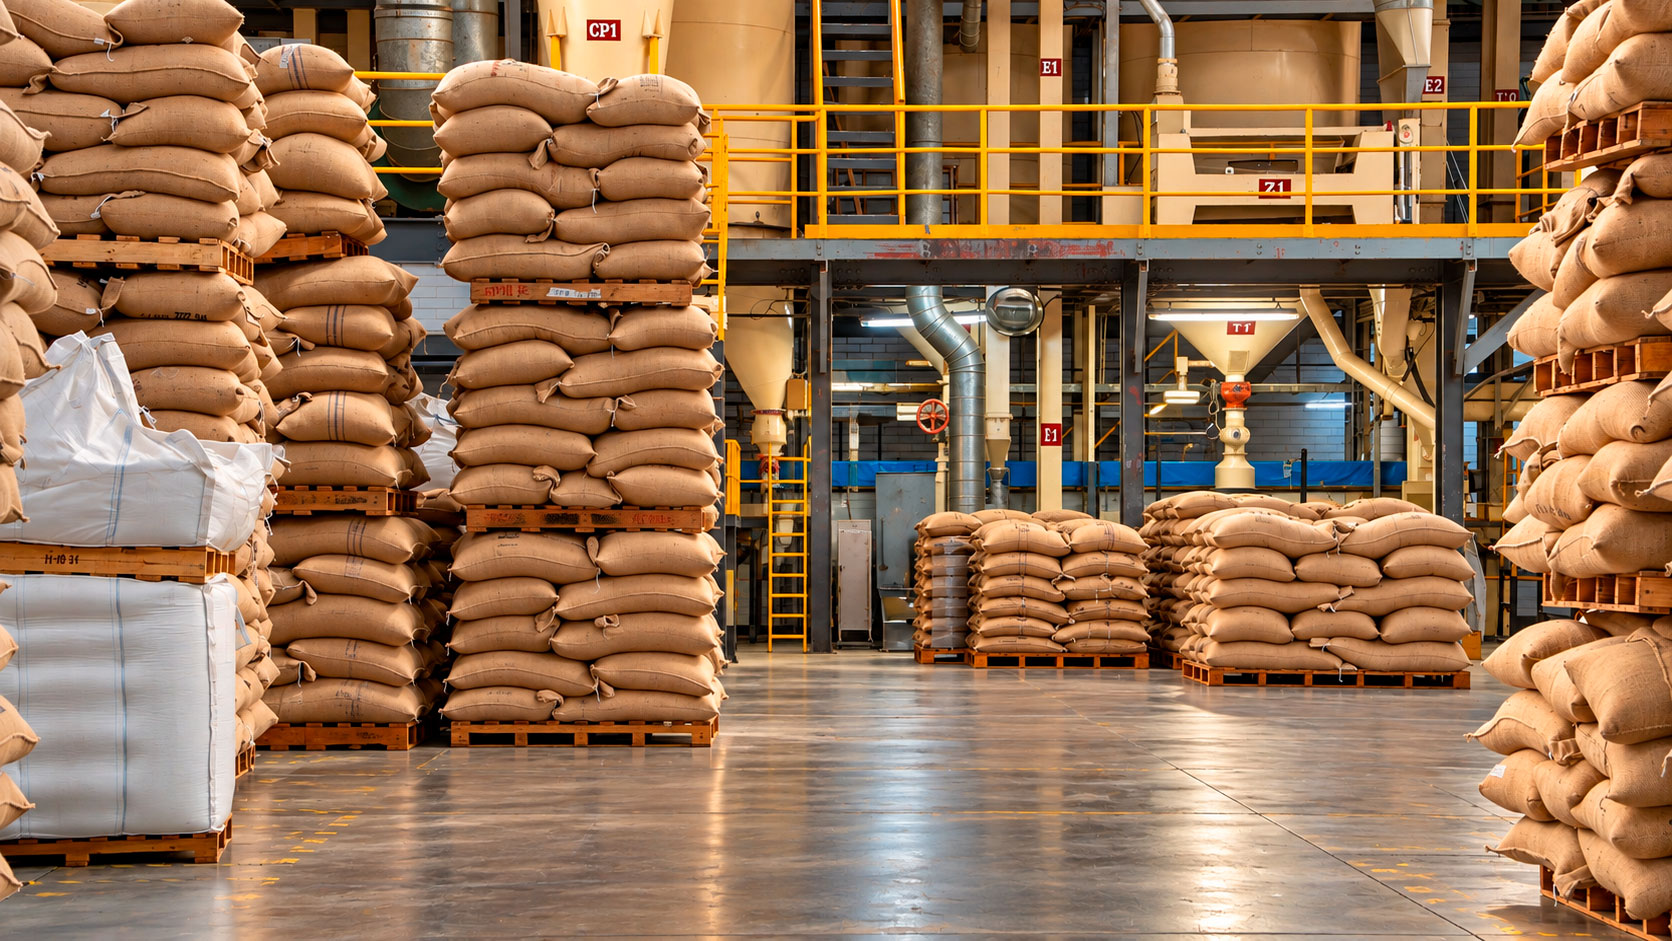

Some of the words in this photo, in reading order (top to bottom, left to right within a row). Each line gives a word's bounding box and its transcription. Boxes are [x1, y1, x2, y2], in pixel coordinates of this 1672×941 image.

[589, 22, 617, 38] CP1
[1042, 61, 1058, 74] E1
[1425, 79, 1442, 92] E2
[1264, 181, 1284, 193] Z1
[1232, 323, 1252, 333] T1
